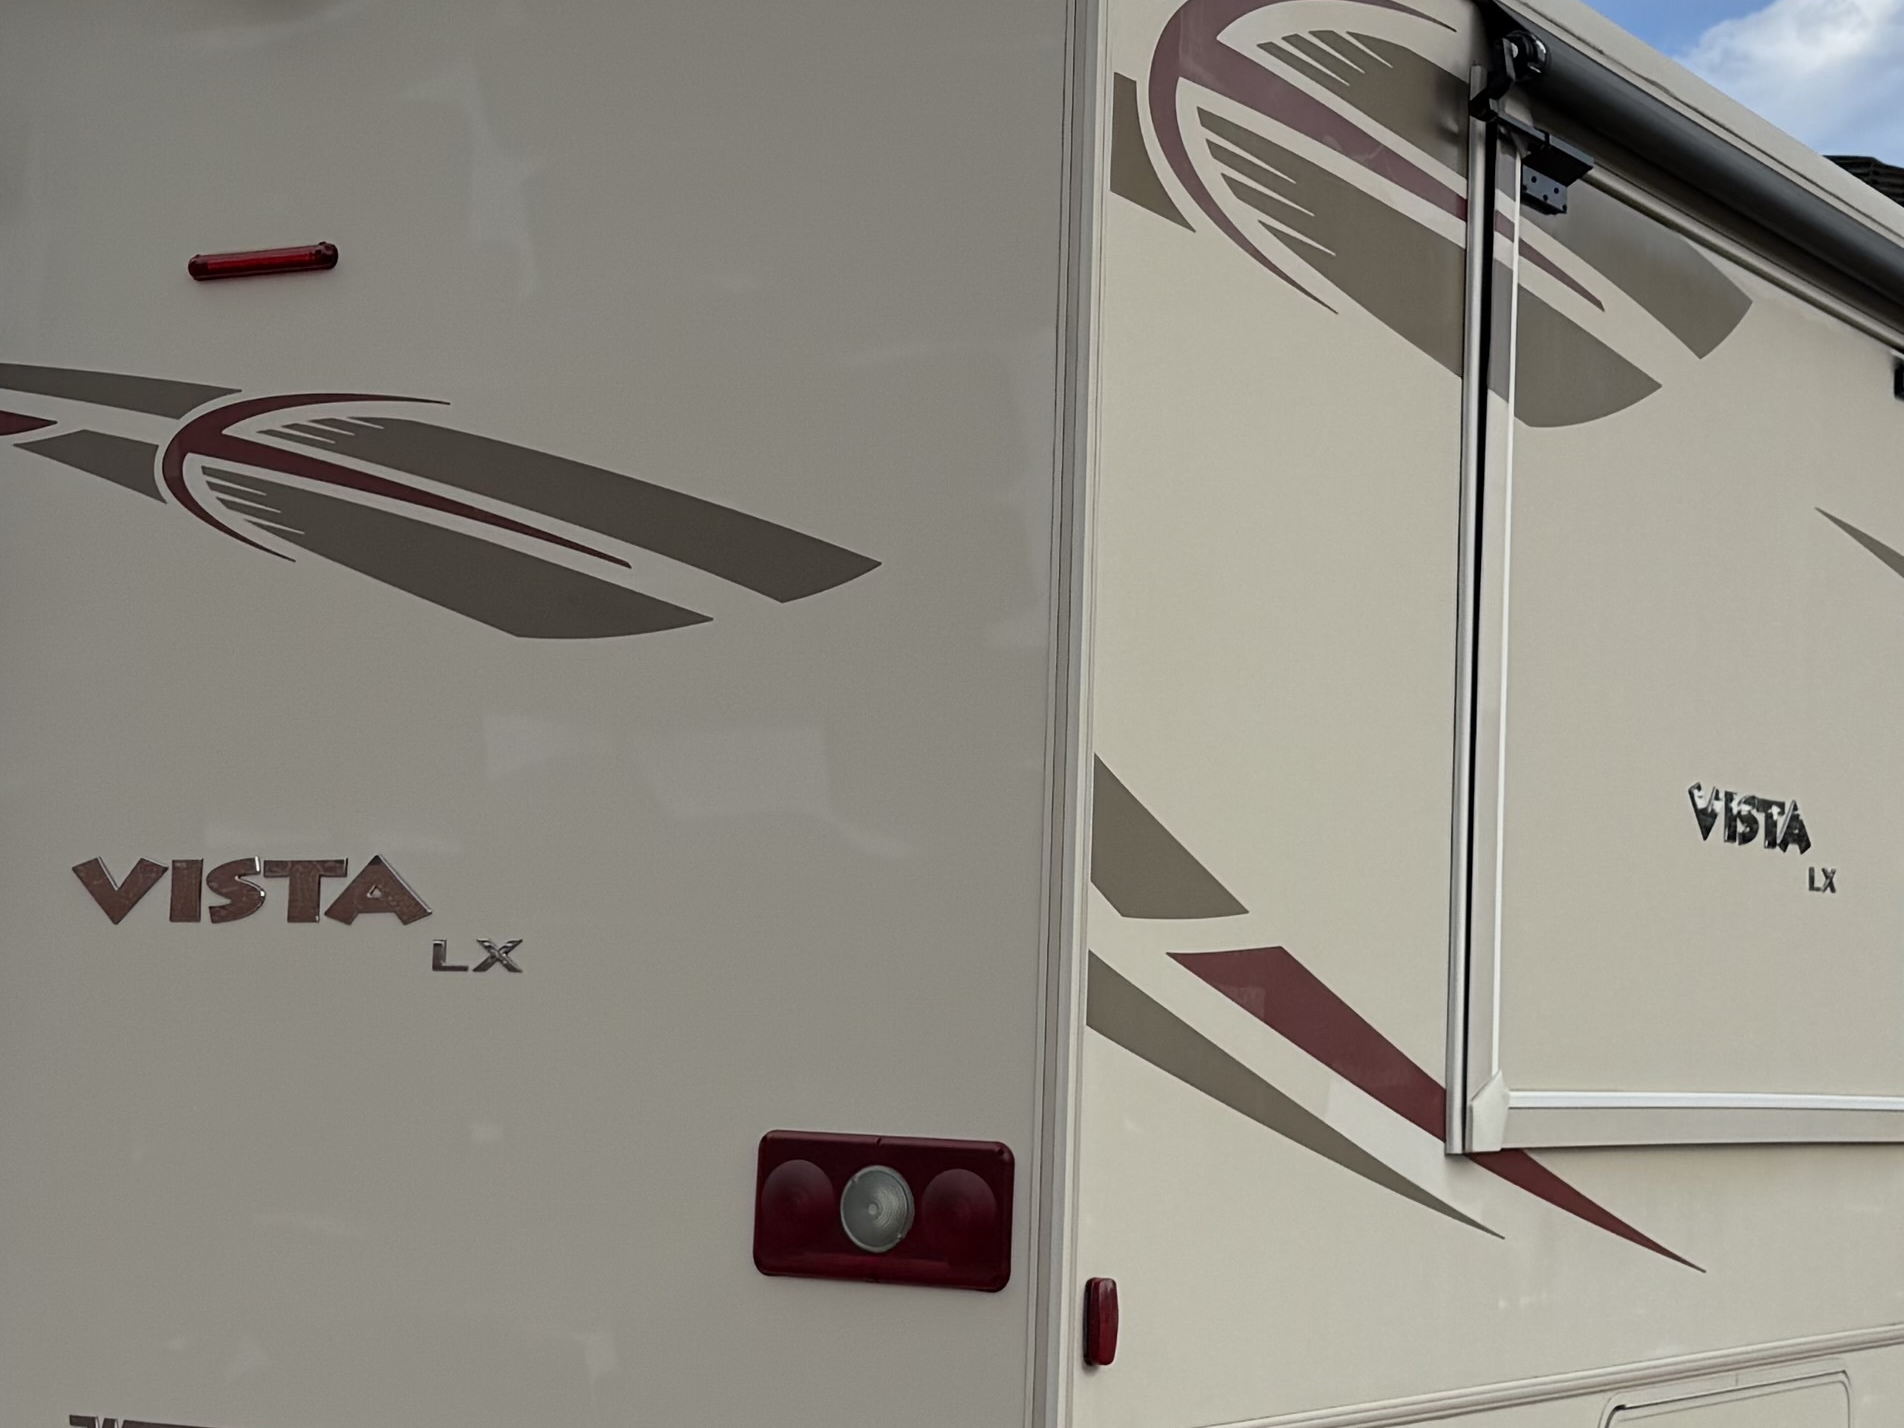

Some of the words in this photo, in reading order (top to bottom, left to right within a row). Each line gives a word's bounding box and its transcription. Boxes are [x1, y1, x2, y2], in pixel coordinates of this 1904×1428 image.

[1688, 782, 1811, 855] VISTA
[72, 854, 432, 925] VISTA
[1808, 866, 1837, 893] LX
[431, 939, 523, 973] LX
